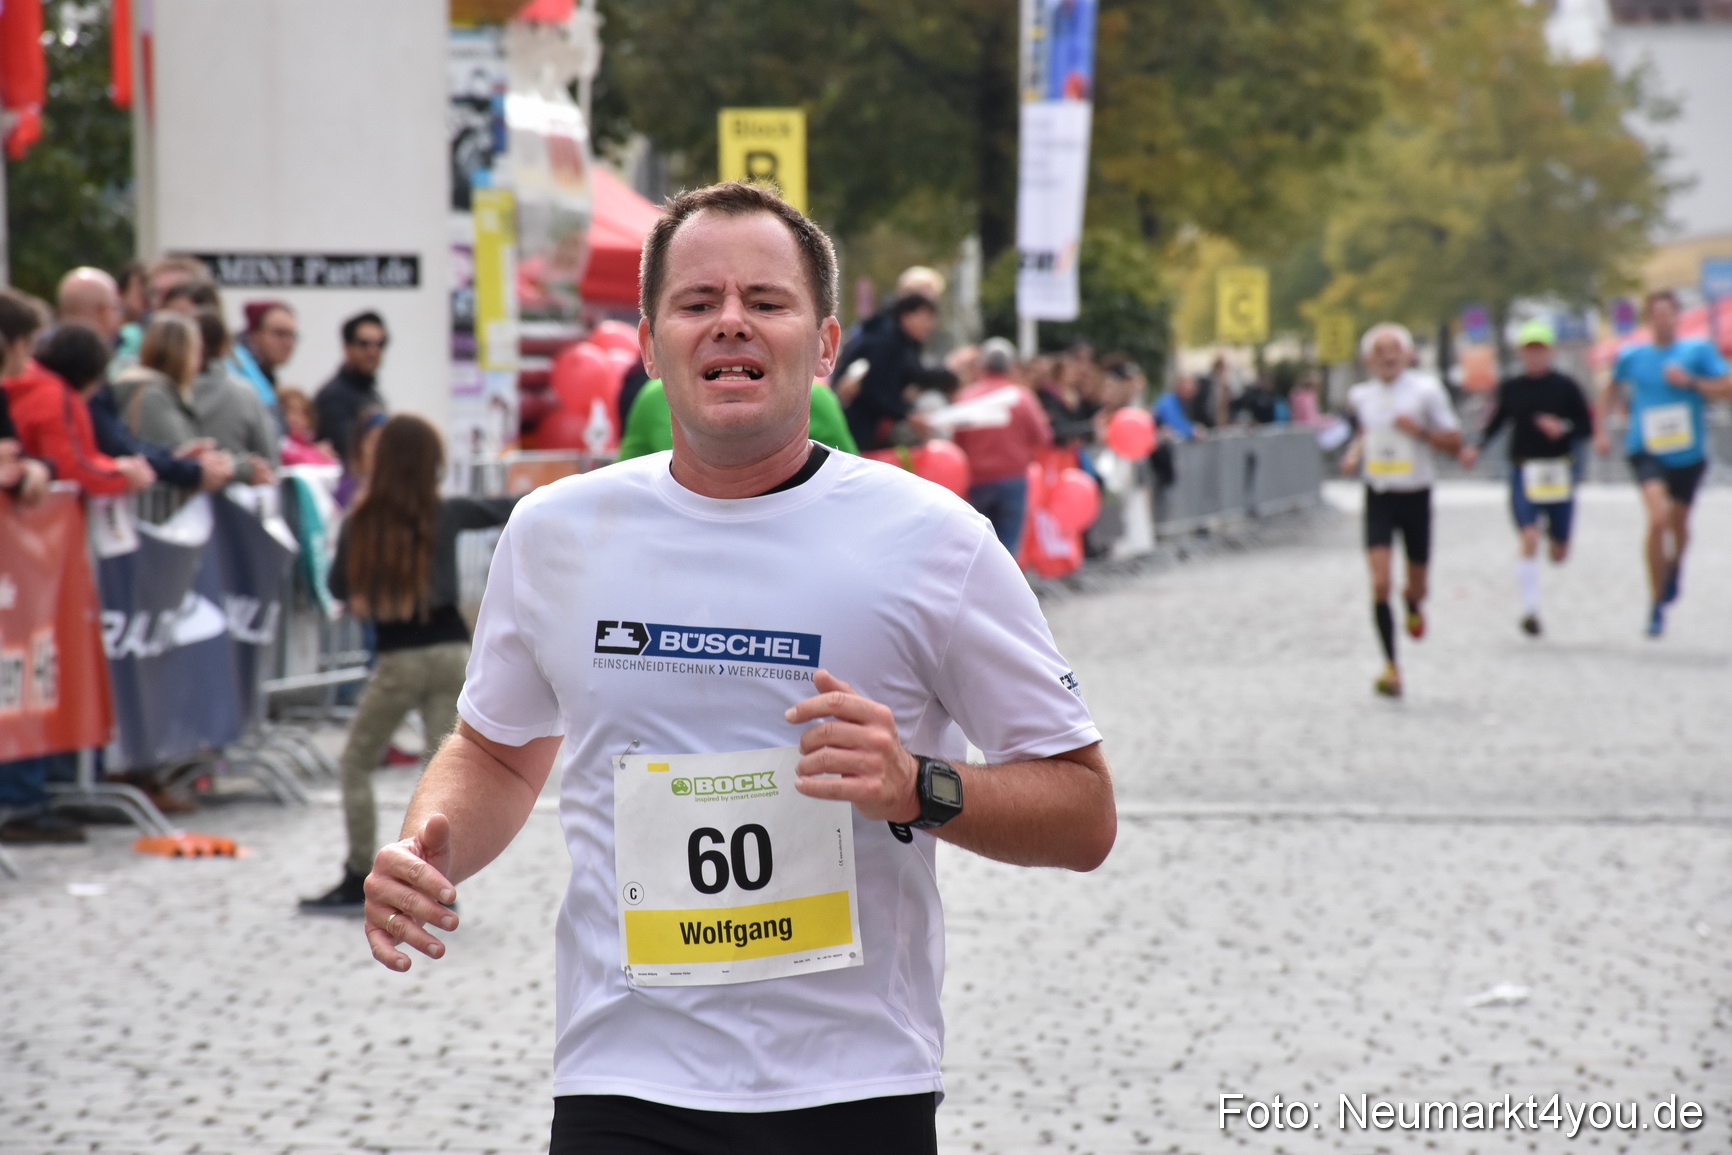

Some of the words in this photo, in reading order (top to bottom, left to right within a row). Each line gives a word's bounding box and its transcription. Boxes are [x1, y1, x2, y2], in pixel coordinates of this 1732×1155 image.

[658, 630, 811, 661] BÜSCHEL
[592, 657, 716, 676] FEINSCHNEIDTECHNIK
[693, 770, 778, 796] BOCK
[694, 795, 720, 803] inspired
[730, 793, 749, 801] smart
[750, 790, 780, 799] concepts
[687, 823, 774, 895] 60
[629, 887, 638, 901] C
[679, 916, 794, 948] Wolfgang
